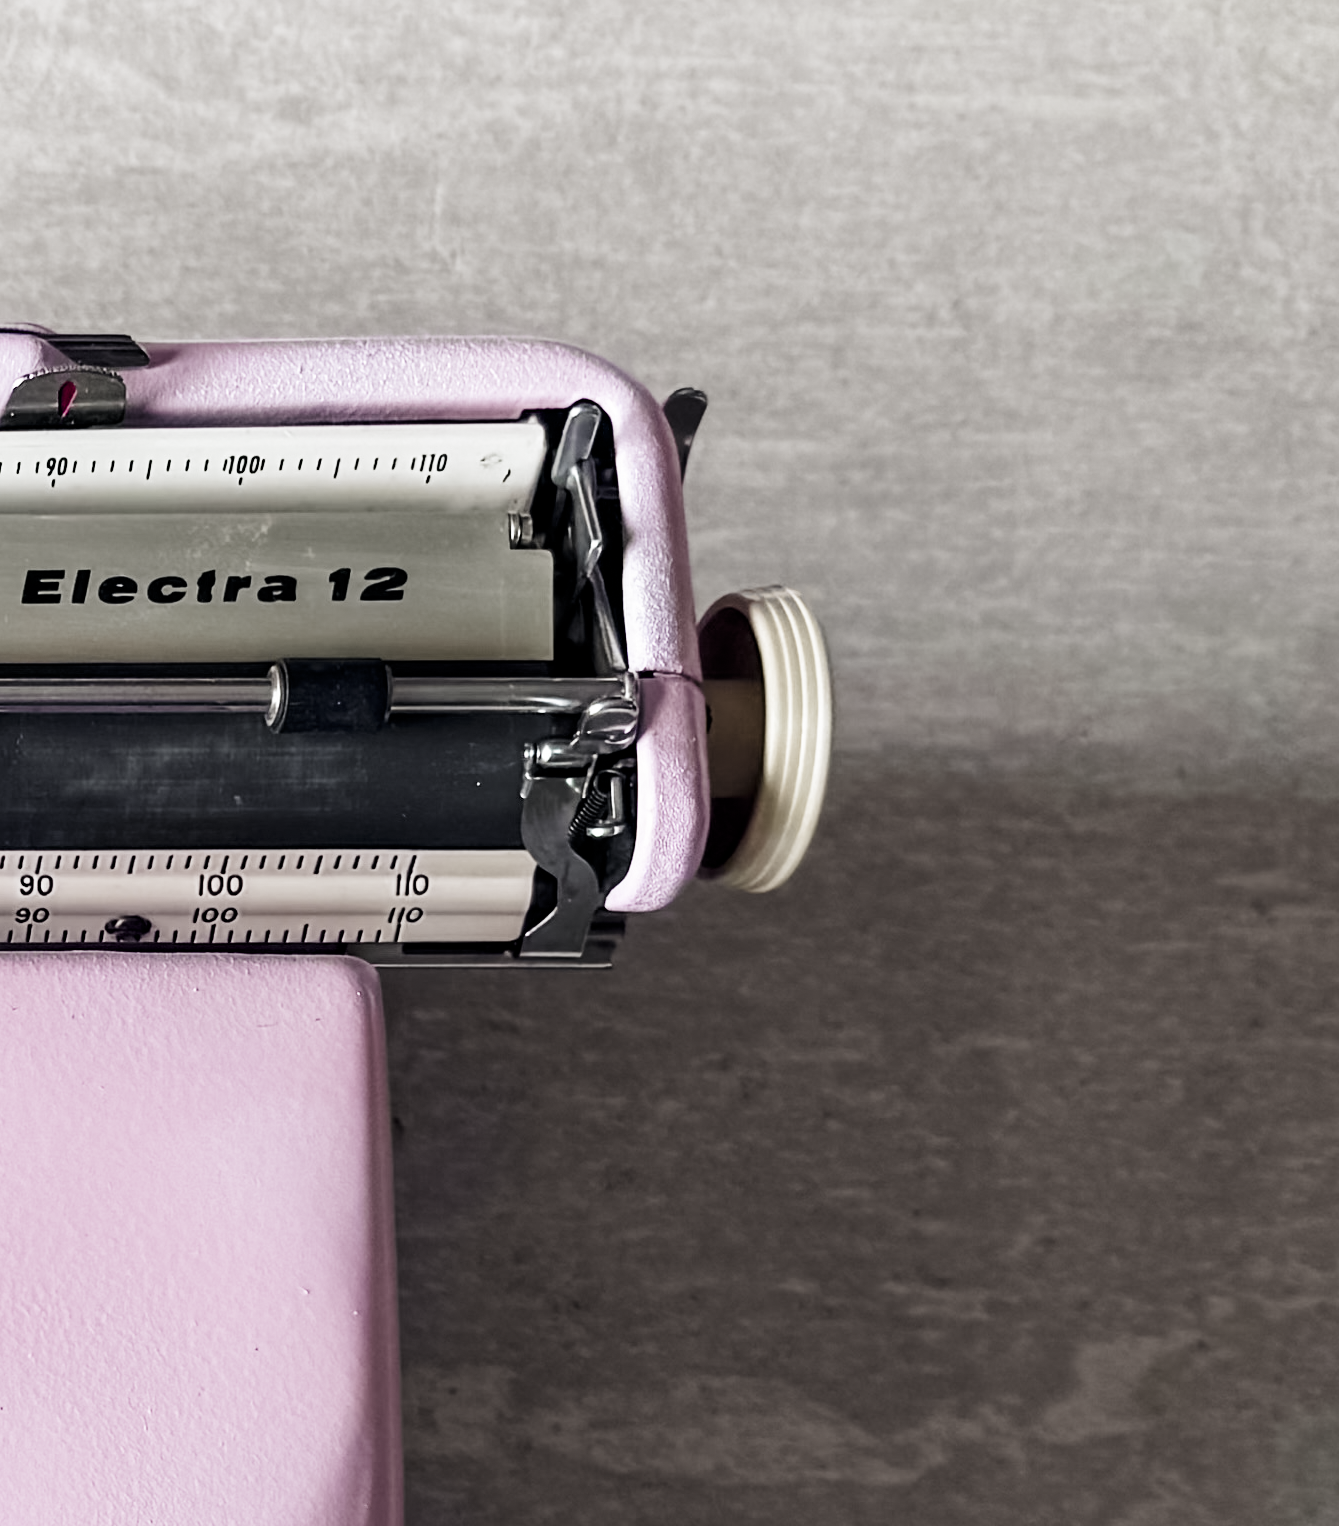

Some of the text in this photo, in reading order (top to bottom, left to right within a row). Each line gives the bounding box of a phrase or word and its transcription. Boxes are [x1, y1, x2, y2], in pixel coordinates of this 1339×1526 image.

[46, 457, 68, 477] 90
[229, 455, 261, 475] 100
[419, 453, 448, 472] 110
[21, 566, 408, 605] Electra 12
[19, 874, 54, 897] 90
[198, 873, 244, 897] 100
[395, 874, 430, 897] 110
[14, 907, 50, 924] 90
[192, 907, 239, 924] 100
[387, 906, 424, 926] 110
